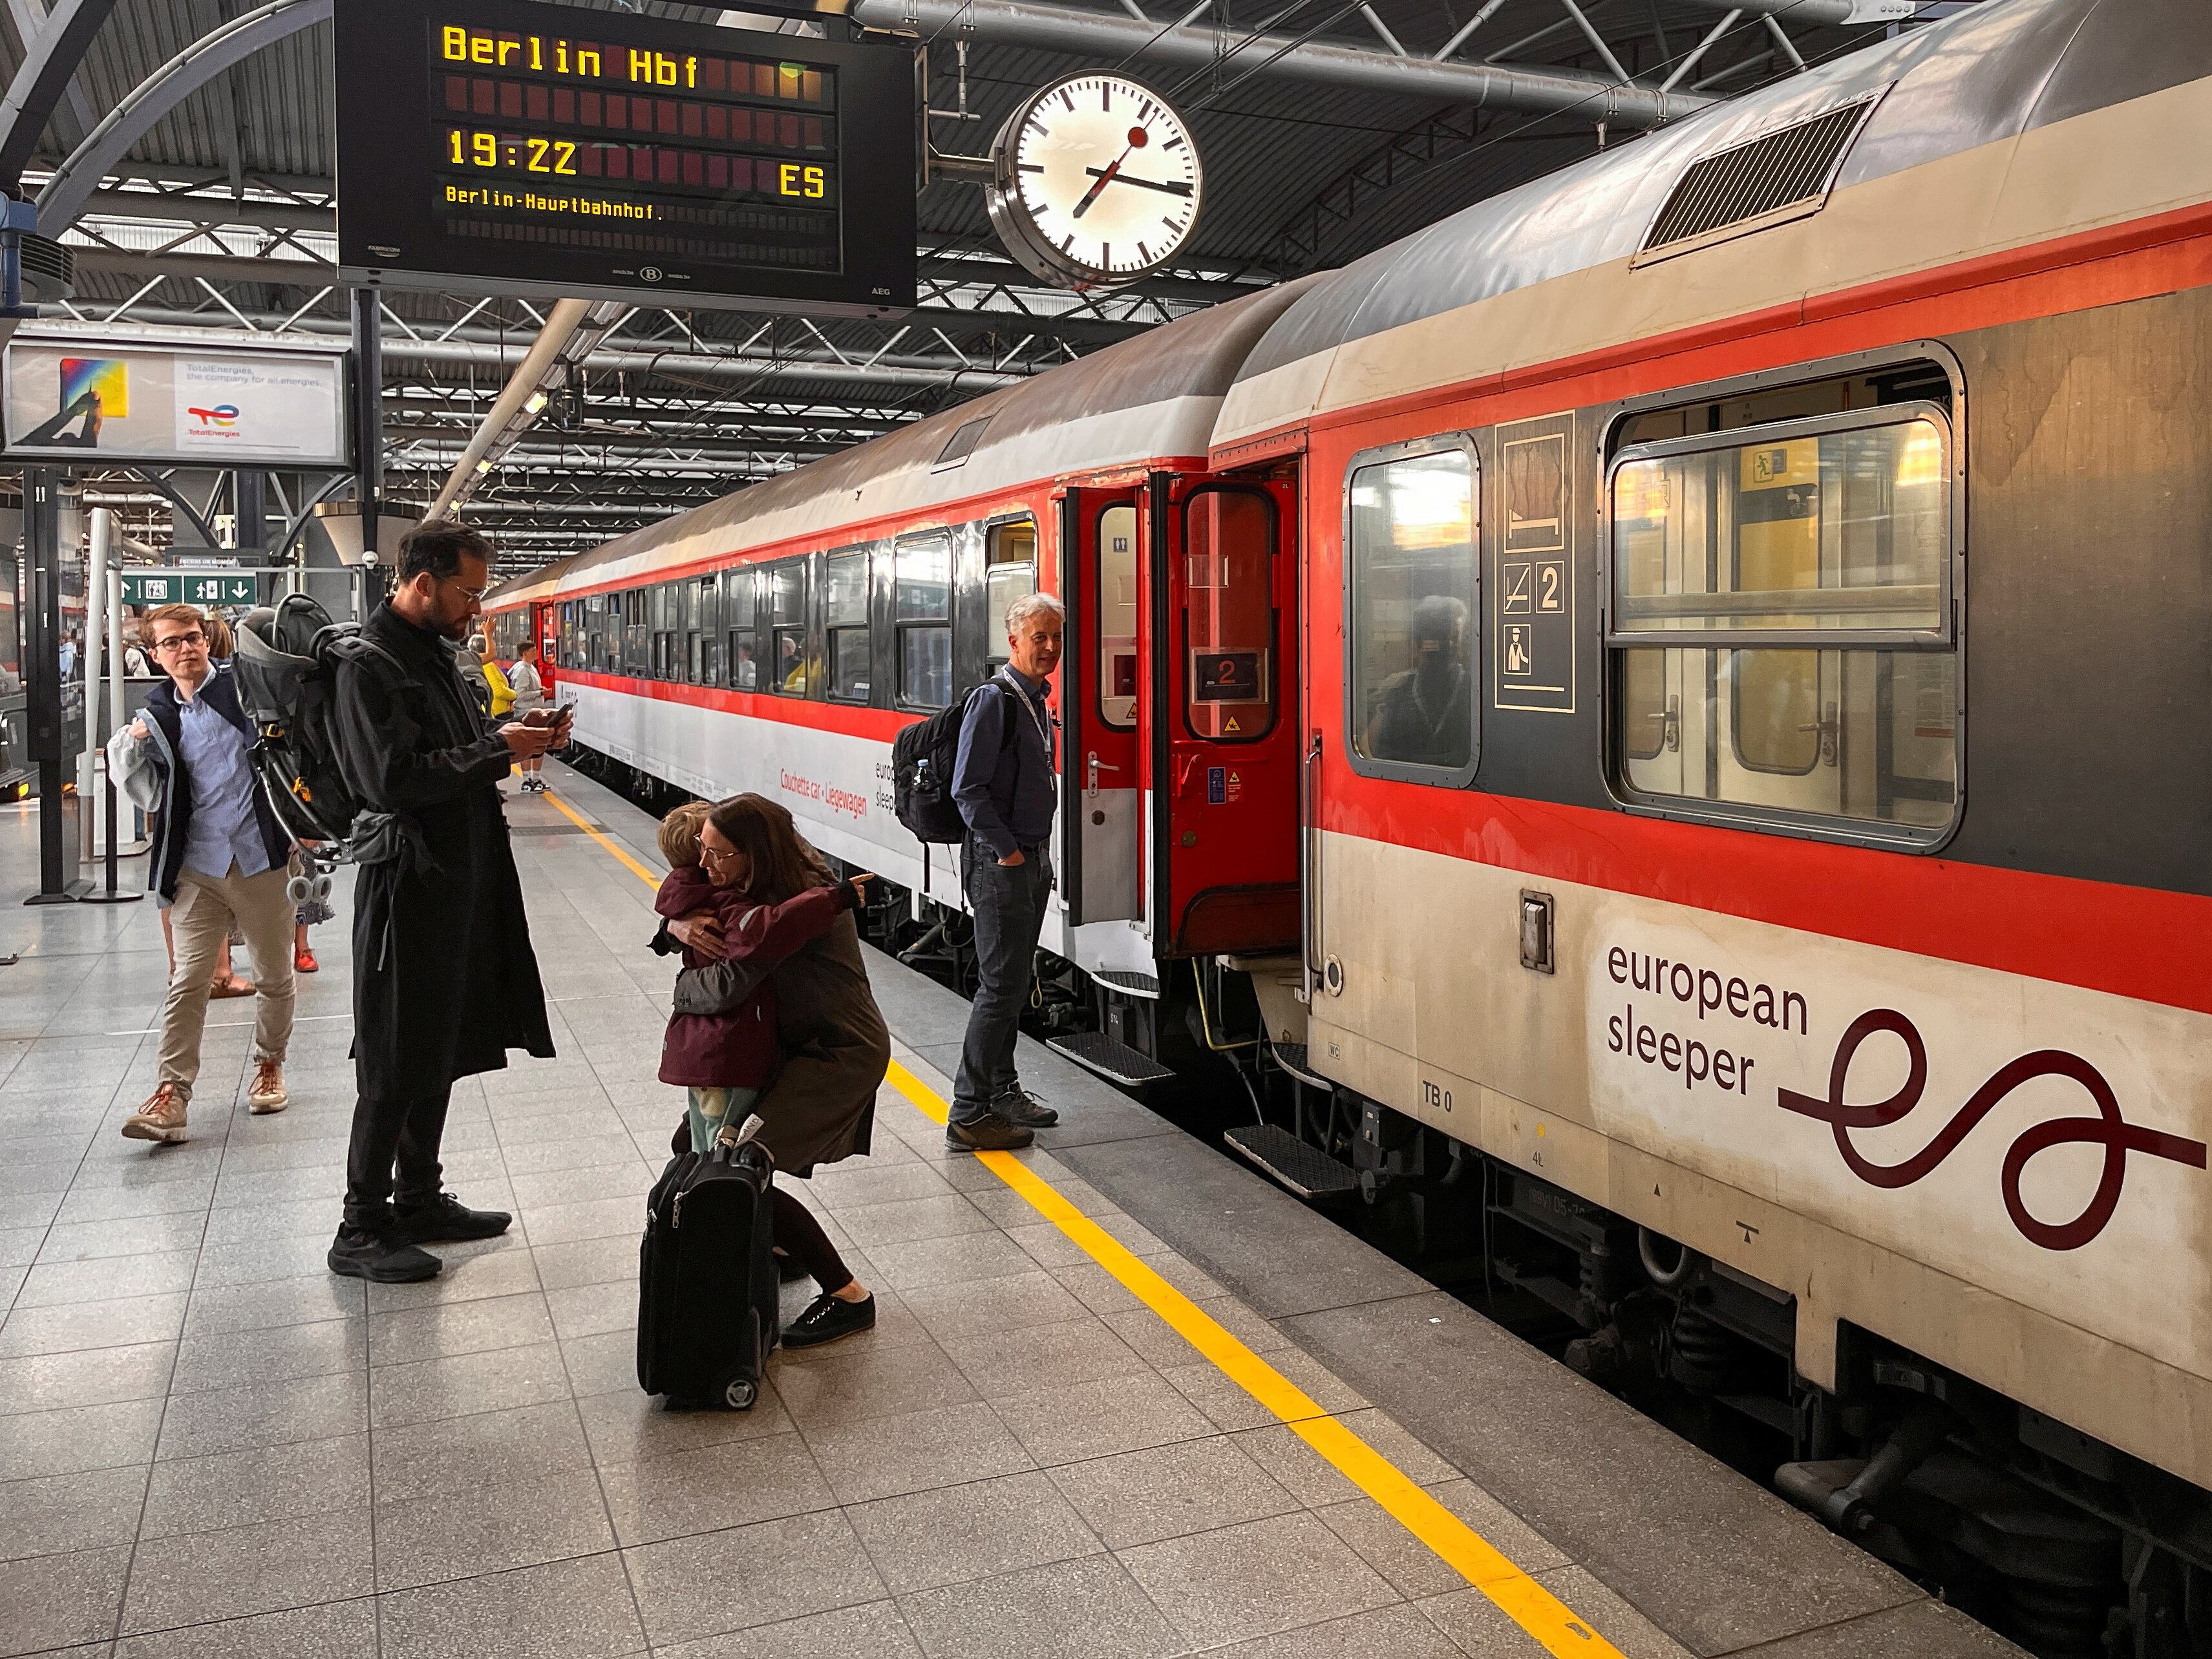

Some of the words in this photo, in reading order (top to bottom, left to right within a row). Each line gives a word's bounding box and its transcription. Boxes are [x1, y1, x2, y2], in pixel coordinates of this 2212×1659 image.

[443, 26, 600, 77] Berlin
[630, 49, 696, 88] Hbf
[451, 131, 576, 174] 19:22
[780, 164, 824, 198] ES
[447, 186, 662, 220] Berlin-Hauptbahnhof.
[871, 287, 890, 295] AEG
[205, 374, 249, 385] company
[251, 375, 264, 384] for
[189, 429, 240, 438] TotalEnergies
[1542, 566, 1558, 608] 2
[1219, 660, 1236, 684] 2
[780, 768, 810, 797] Couchette
[811, 782, 820, 800] car
[825, 781, 867, 819] Liegewagen
[876, 785, 896, 815] sleep
[1608, 946, 1807, 1035] european
[1330, 1044, 1339, 1057] WC
[1608, 1003, 1754, 1095] sleeper
[1423, 1080, 1441, 1107] TB
